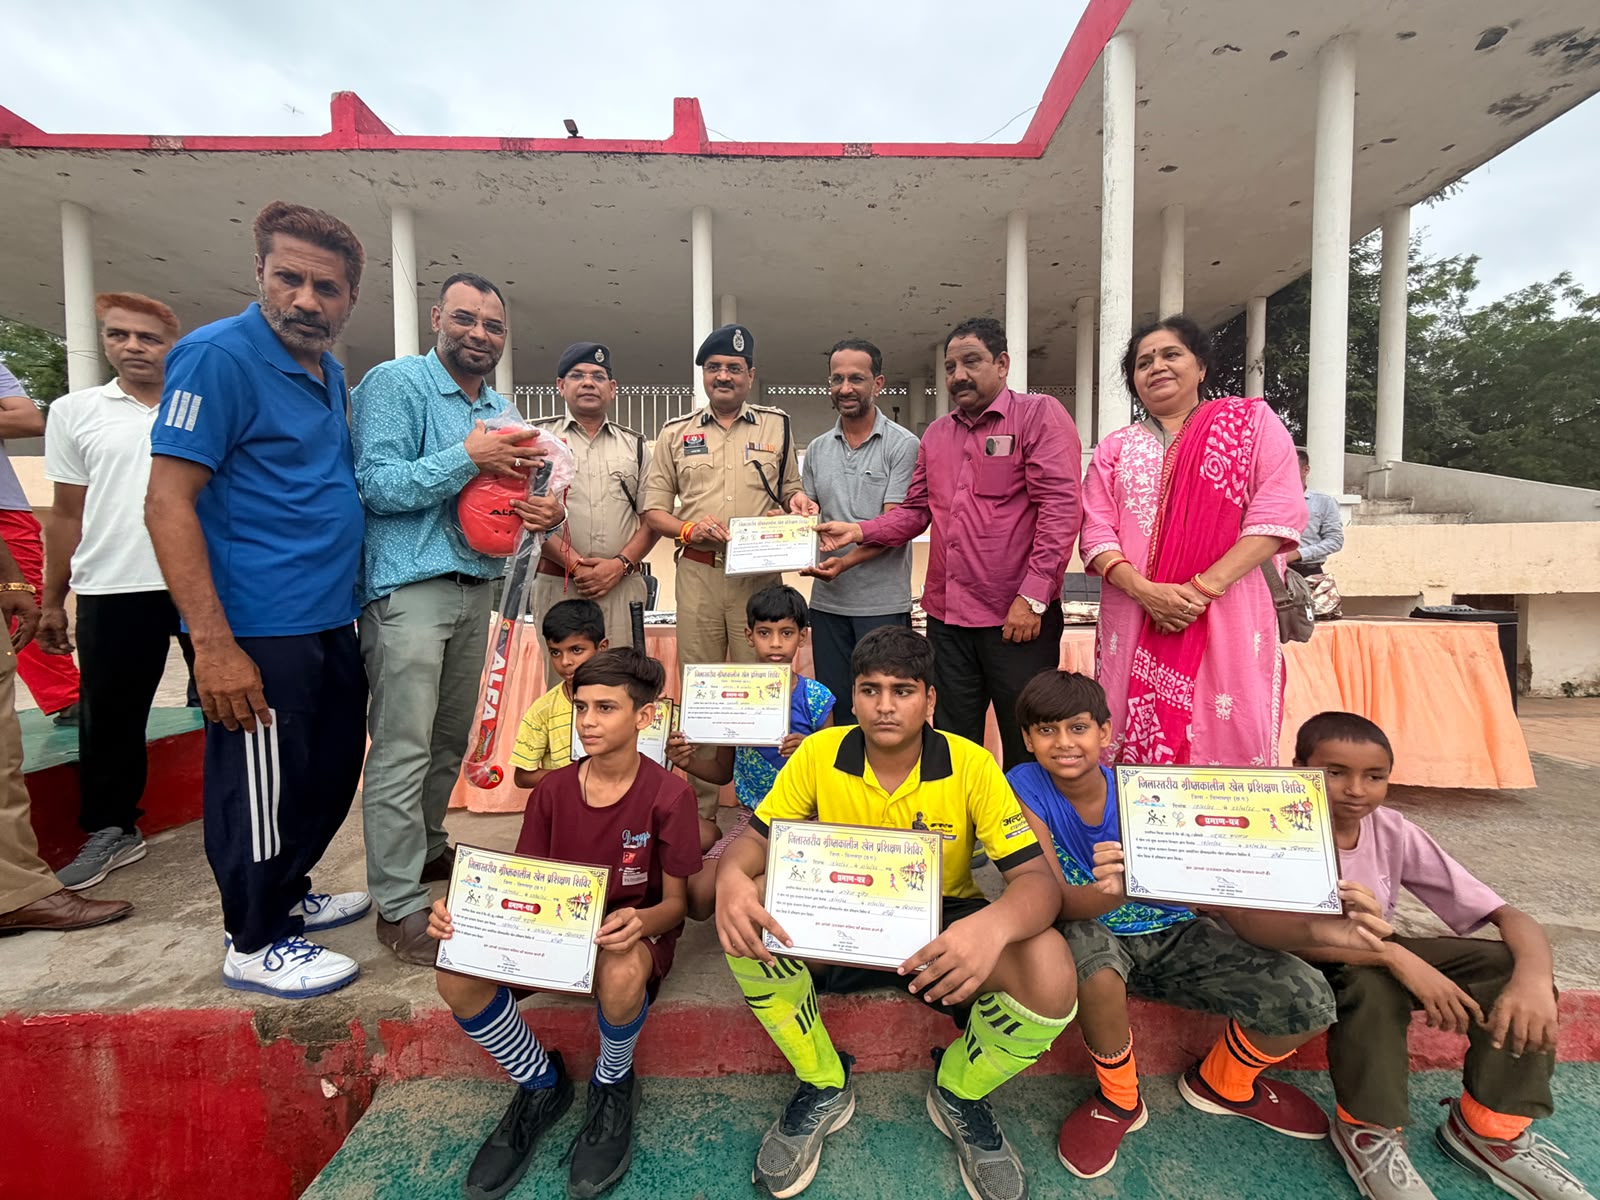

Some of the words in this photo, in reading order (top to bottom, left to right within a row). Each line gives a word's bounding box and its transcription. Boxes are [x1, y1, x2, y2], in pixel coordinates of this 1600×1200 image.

[481, 650, 506, 721] ALFA
[1138, 776, 1179, 790] जिलास्तरीय
[1181, 777, 1226, 791] ग्रीष्मकालीन
[1228, 779, 1245, 792] खेल
[1247, 779, 1279, 794] प्रशिक्षण
[1281, 780, 1306, 794] शिविर
[904, 842, 924, 856] शिविर
